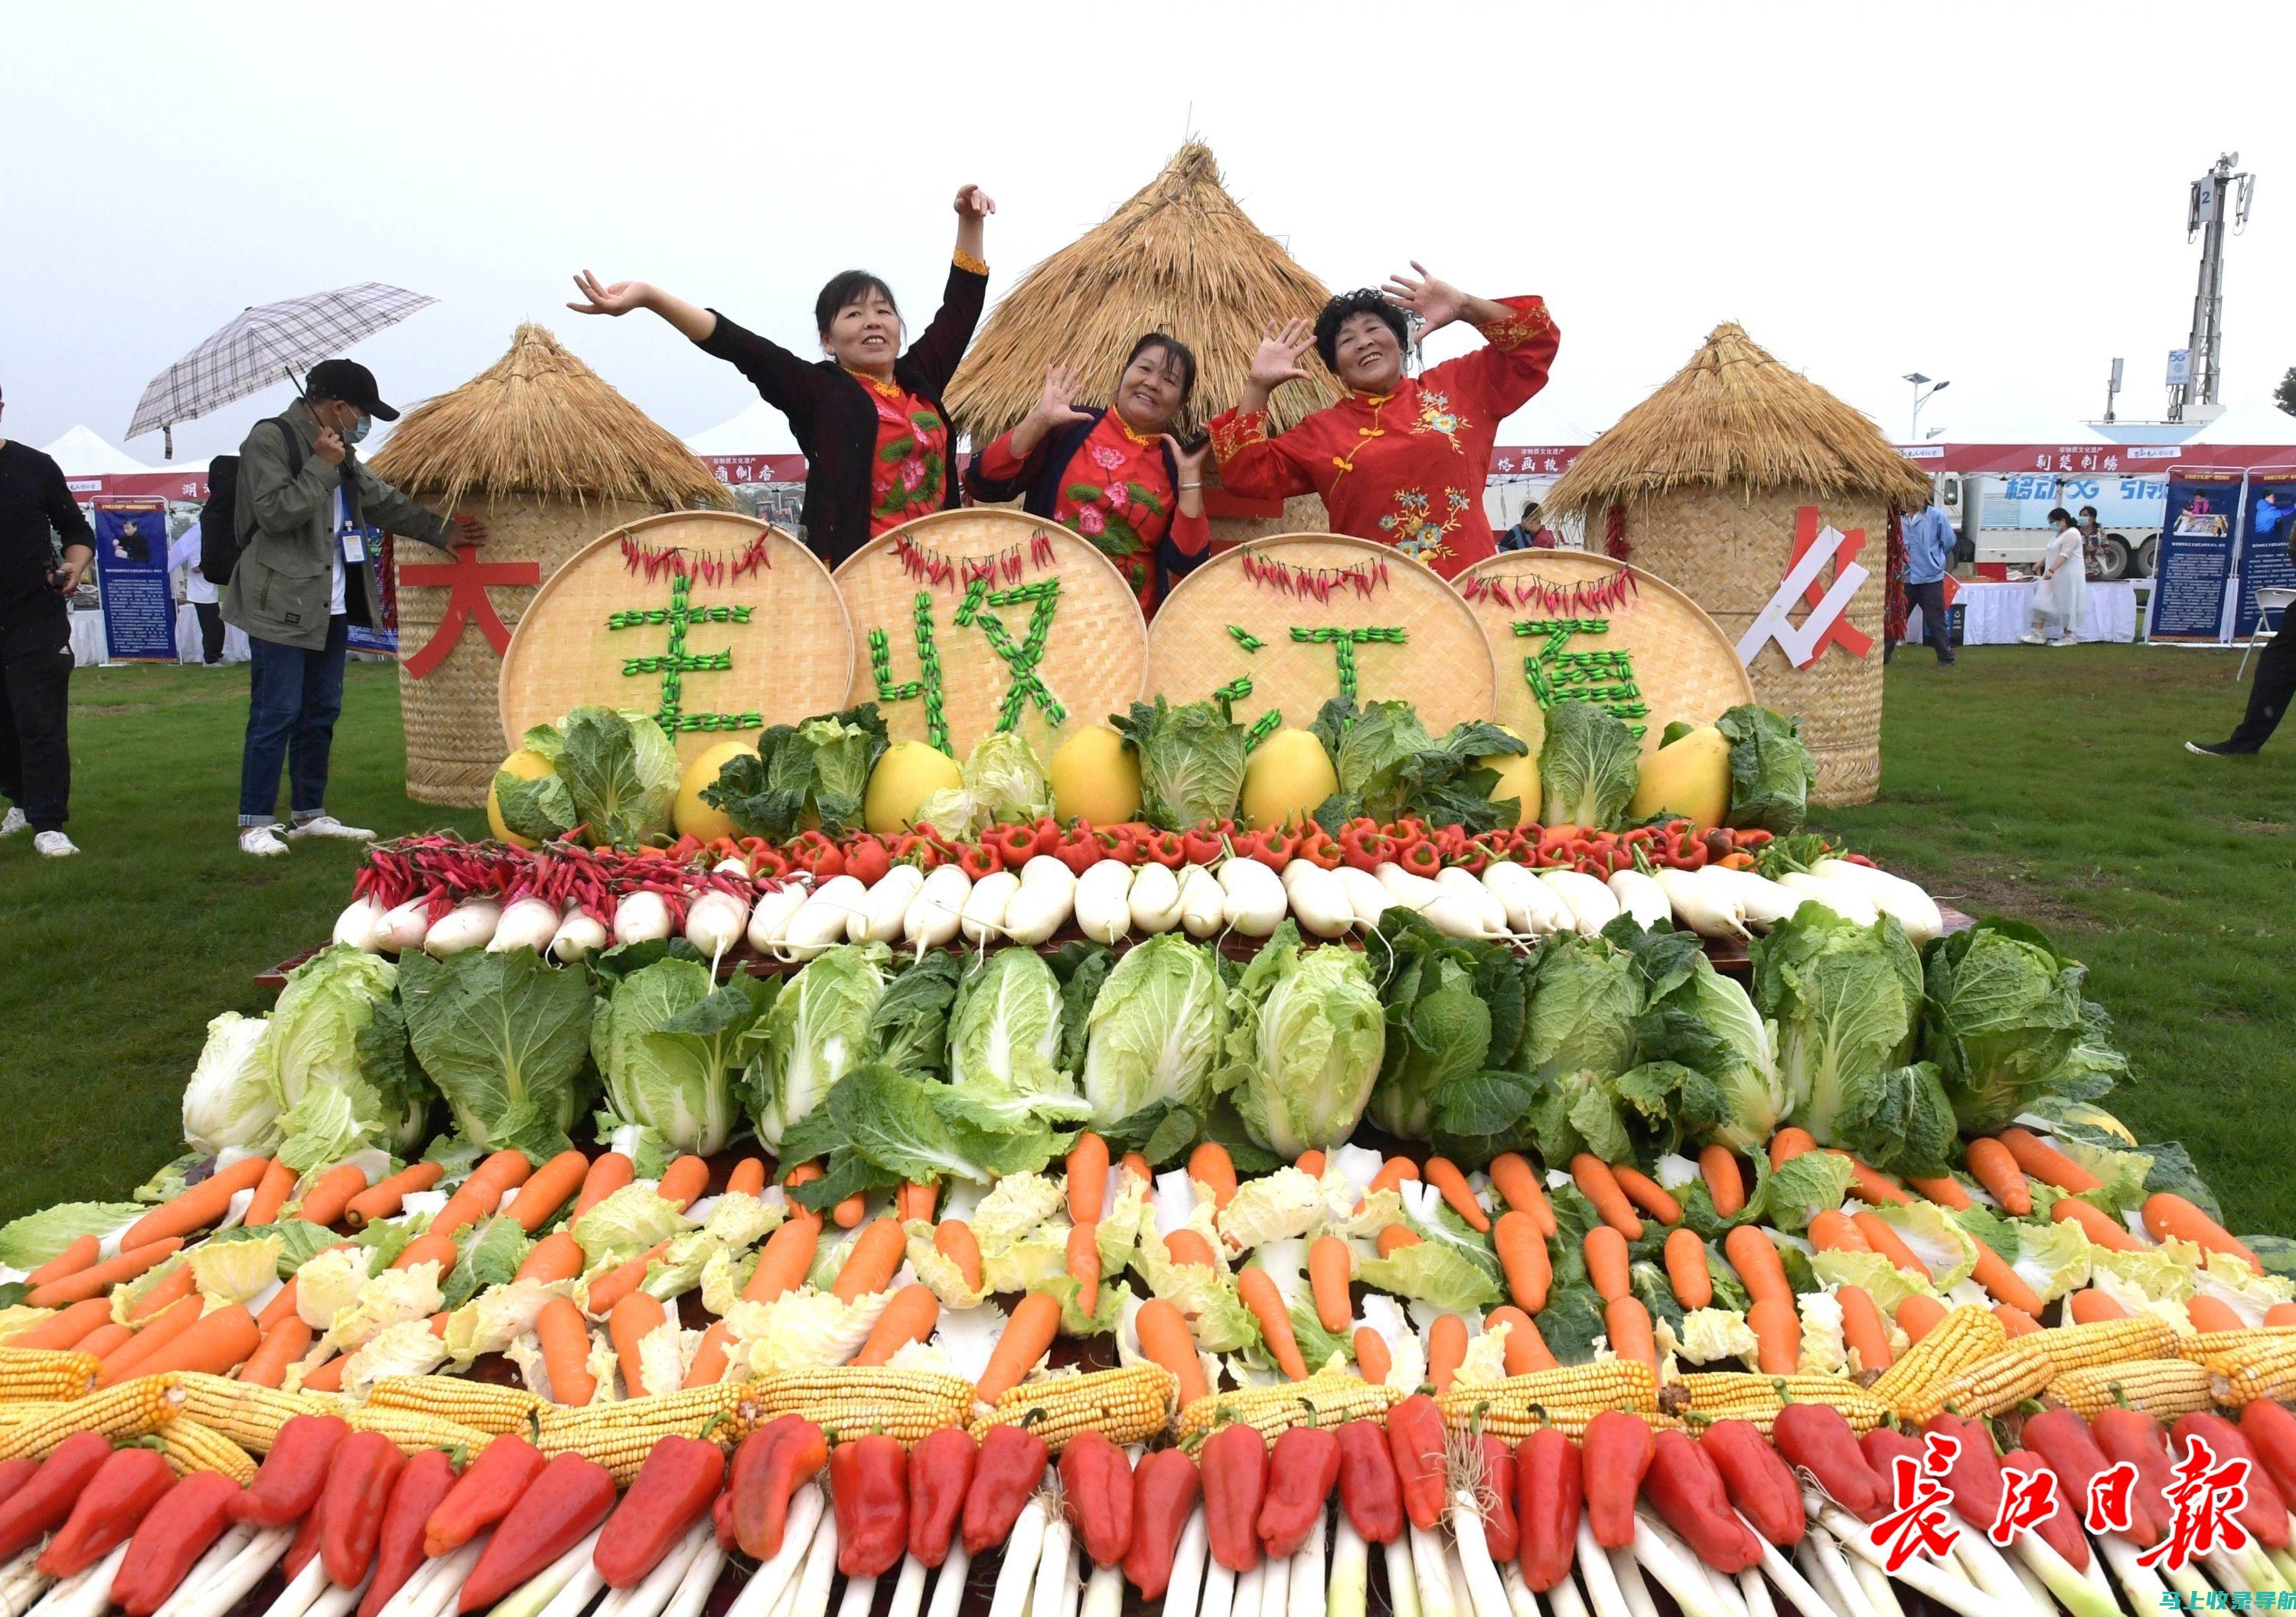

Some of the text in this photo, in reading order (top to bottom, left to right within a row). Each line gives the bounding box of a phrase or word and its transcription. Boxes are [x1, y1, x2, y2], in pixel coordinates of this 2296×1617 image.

[2202, 191, 2210, 204] 2
[2036, 453, 2118, 472] 荆楚刺绣
